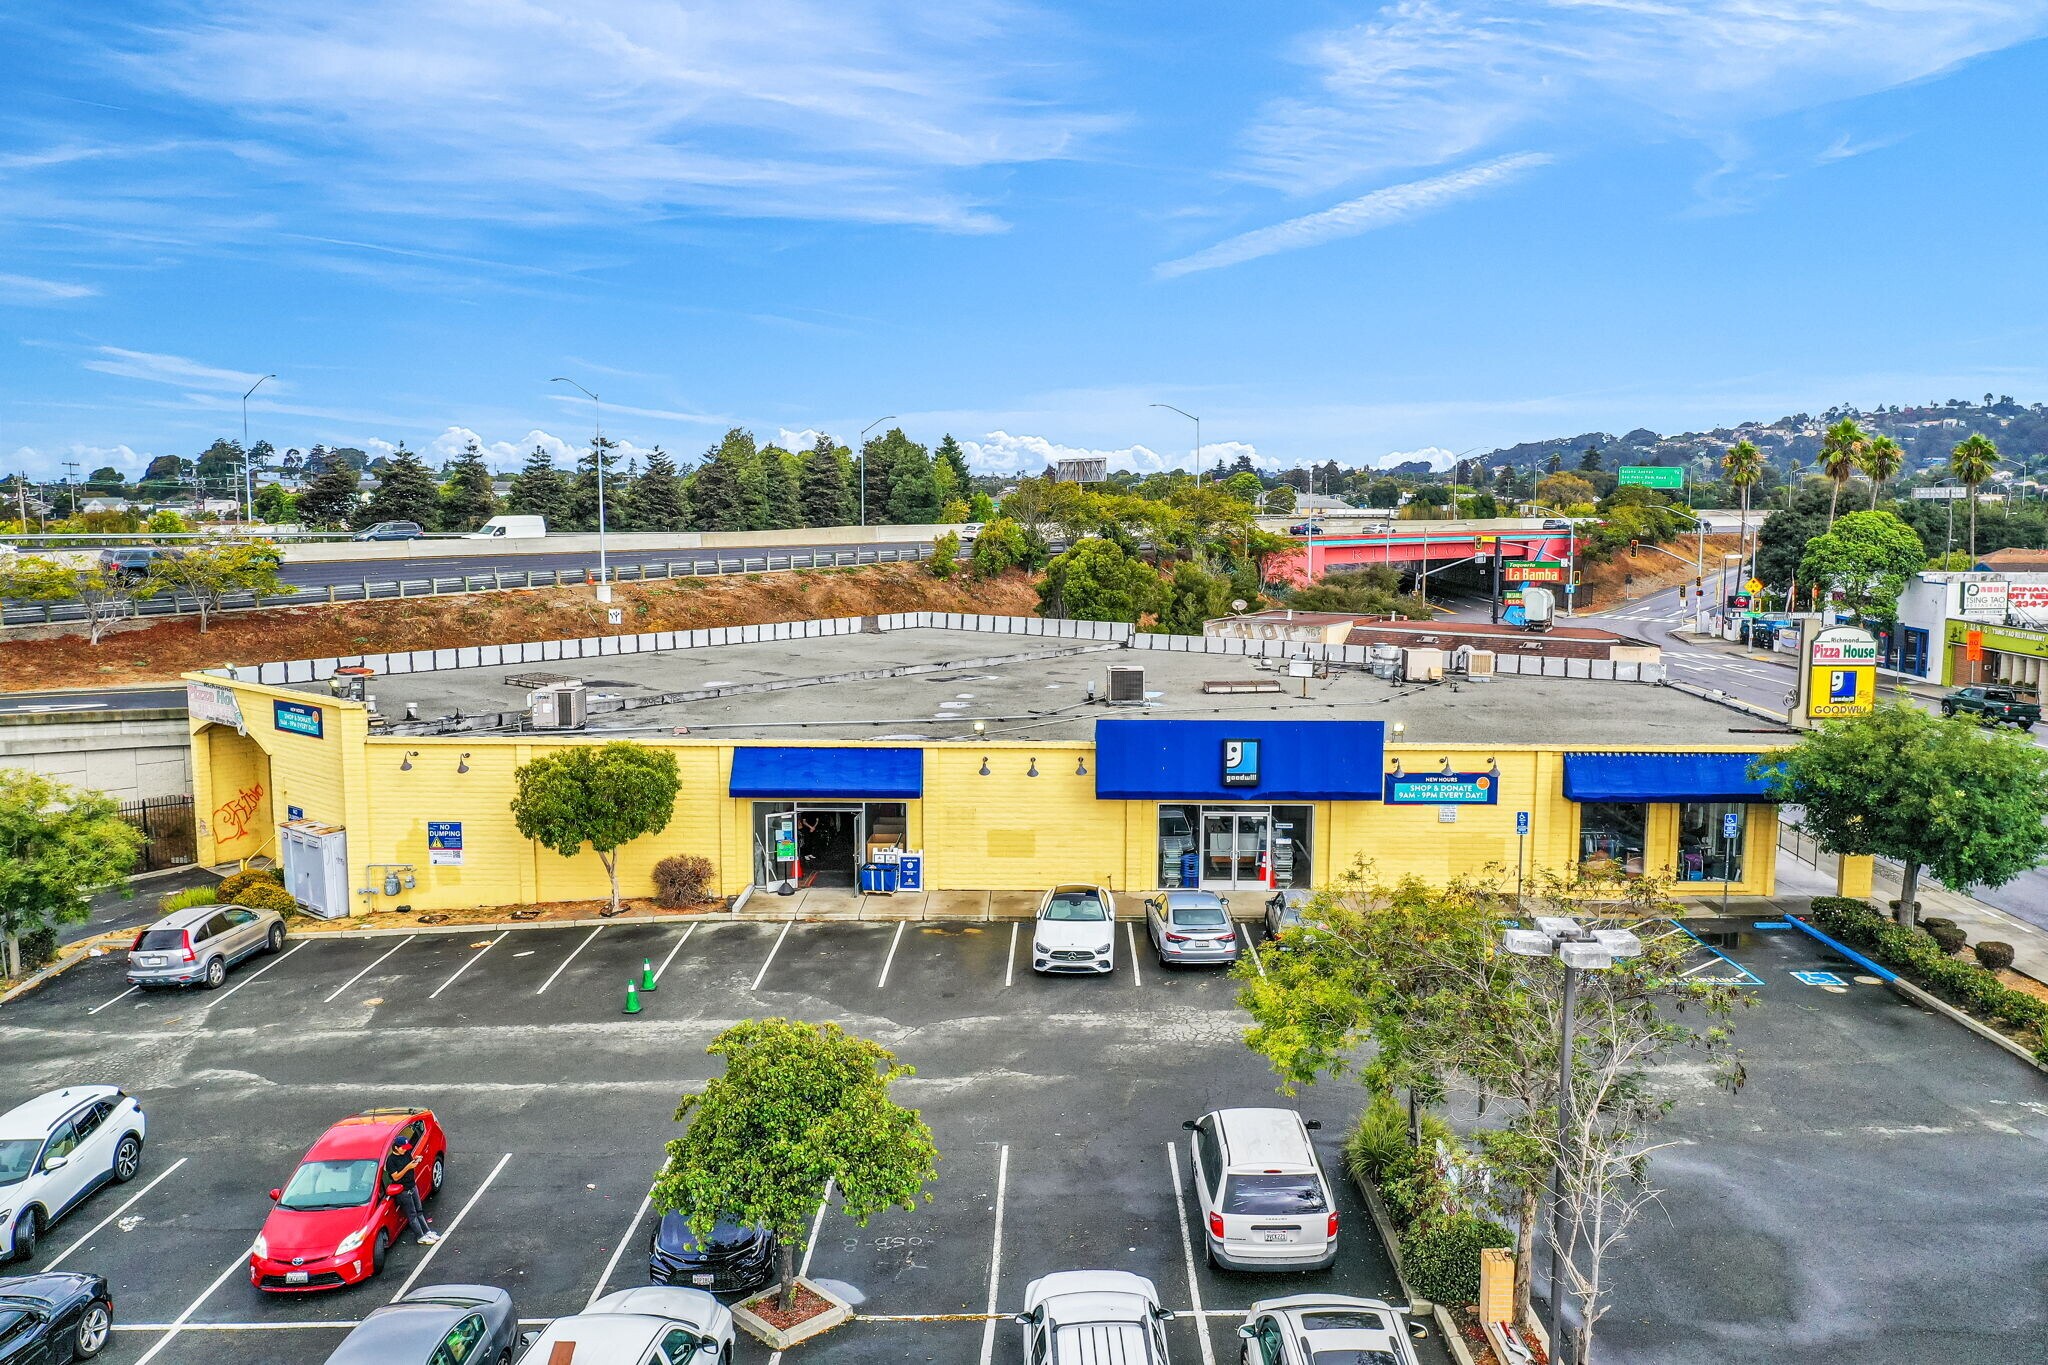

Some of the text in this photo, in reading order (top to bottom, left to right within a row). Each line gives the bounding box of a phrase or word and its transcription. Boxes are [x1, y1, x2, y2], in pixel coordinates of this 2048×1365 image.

[1509, 568, 1558, 581] La Bamba
[1814, 644, 1875, 659] Pizza House
[1226, 773, 1257, 783] goodwill
